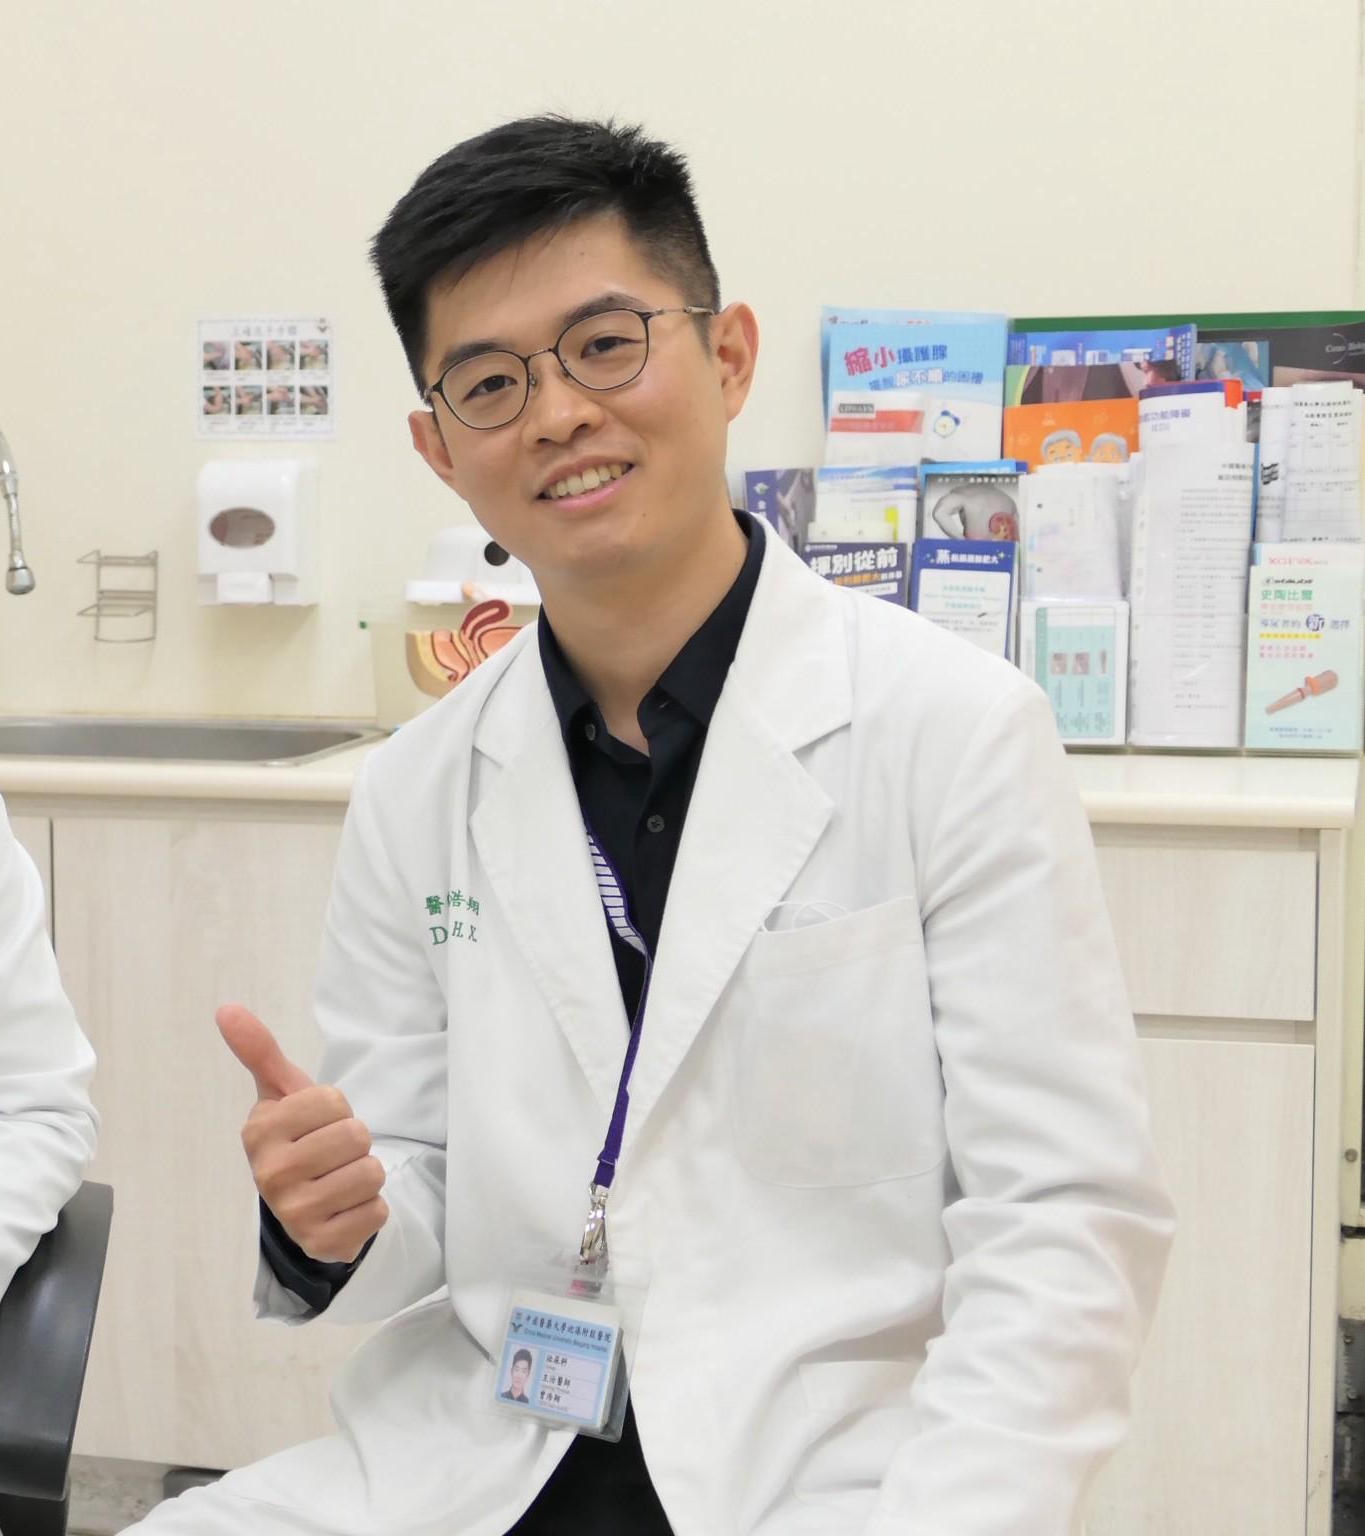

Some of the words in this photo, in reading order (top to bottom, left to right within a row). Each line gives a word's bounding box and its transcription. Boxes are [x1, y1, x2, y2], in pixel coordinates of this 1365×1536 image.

[844, 344, 947, 376] 縮小攝護腺
